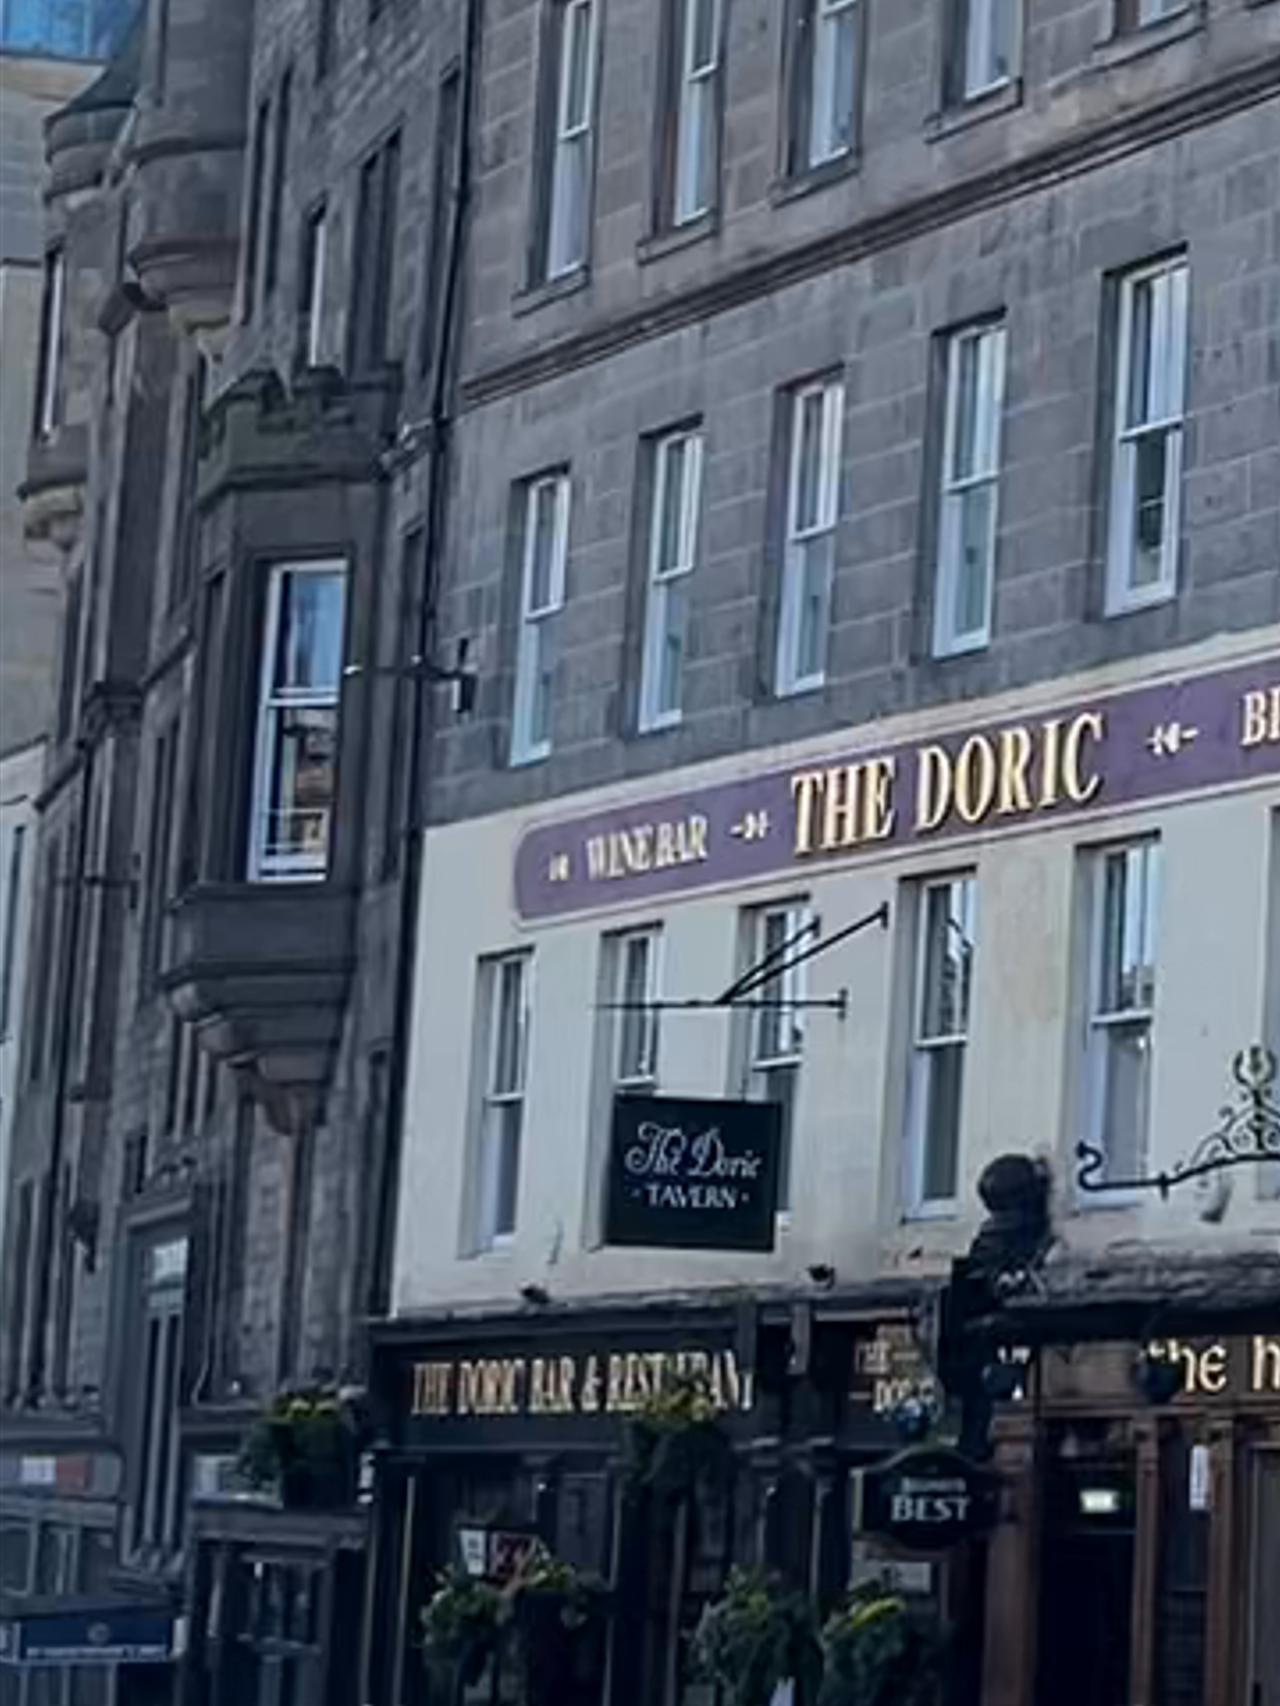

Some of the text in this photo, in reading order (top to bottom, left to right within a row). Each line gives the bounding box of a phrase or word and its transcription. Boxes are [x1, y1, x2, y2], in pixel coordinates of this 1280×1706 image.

[585, 822, 653, 879] WINE
[654, 815, 708, 867] BAR
[791, 757, 896, 854] THE
[914, 713, 1102, 834] DORIC
[624, 1121, 762, 1178] The Doric
[645, 1183, 738, 1208] TAVERN
[411, 1362, 452, 1414] THE
[457, 1358, 525, 1413] DORIC
[529, 1357, 576, 1412] BAR
[581, 1355, 601, 1411] &
[890, 1494, 971, 1522] BEST
